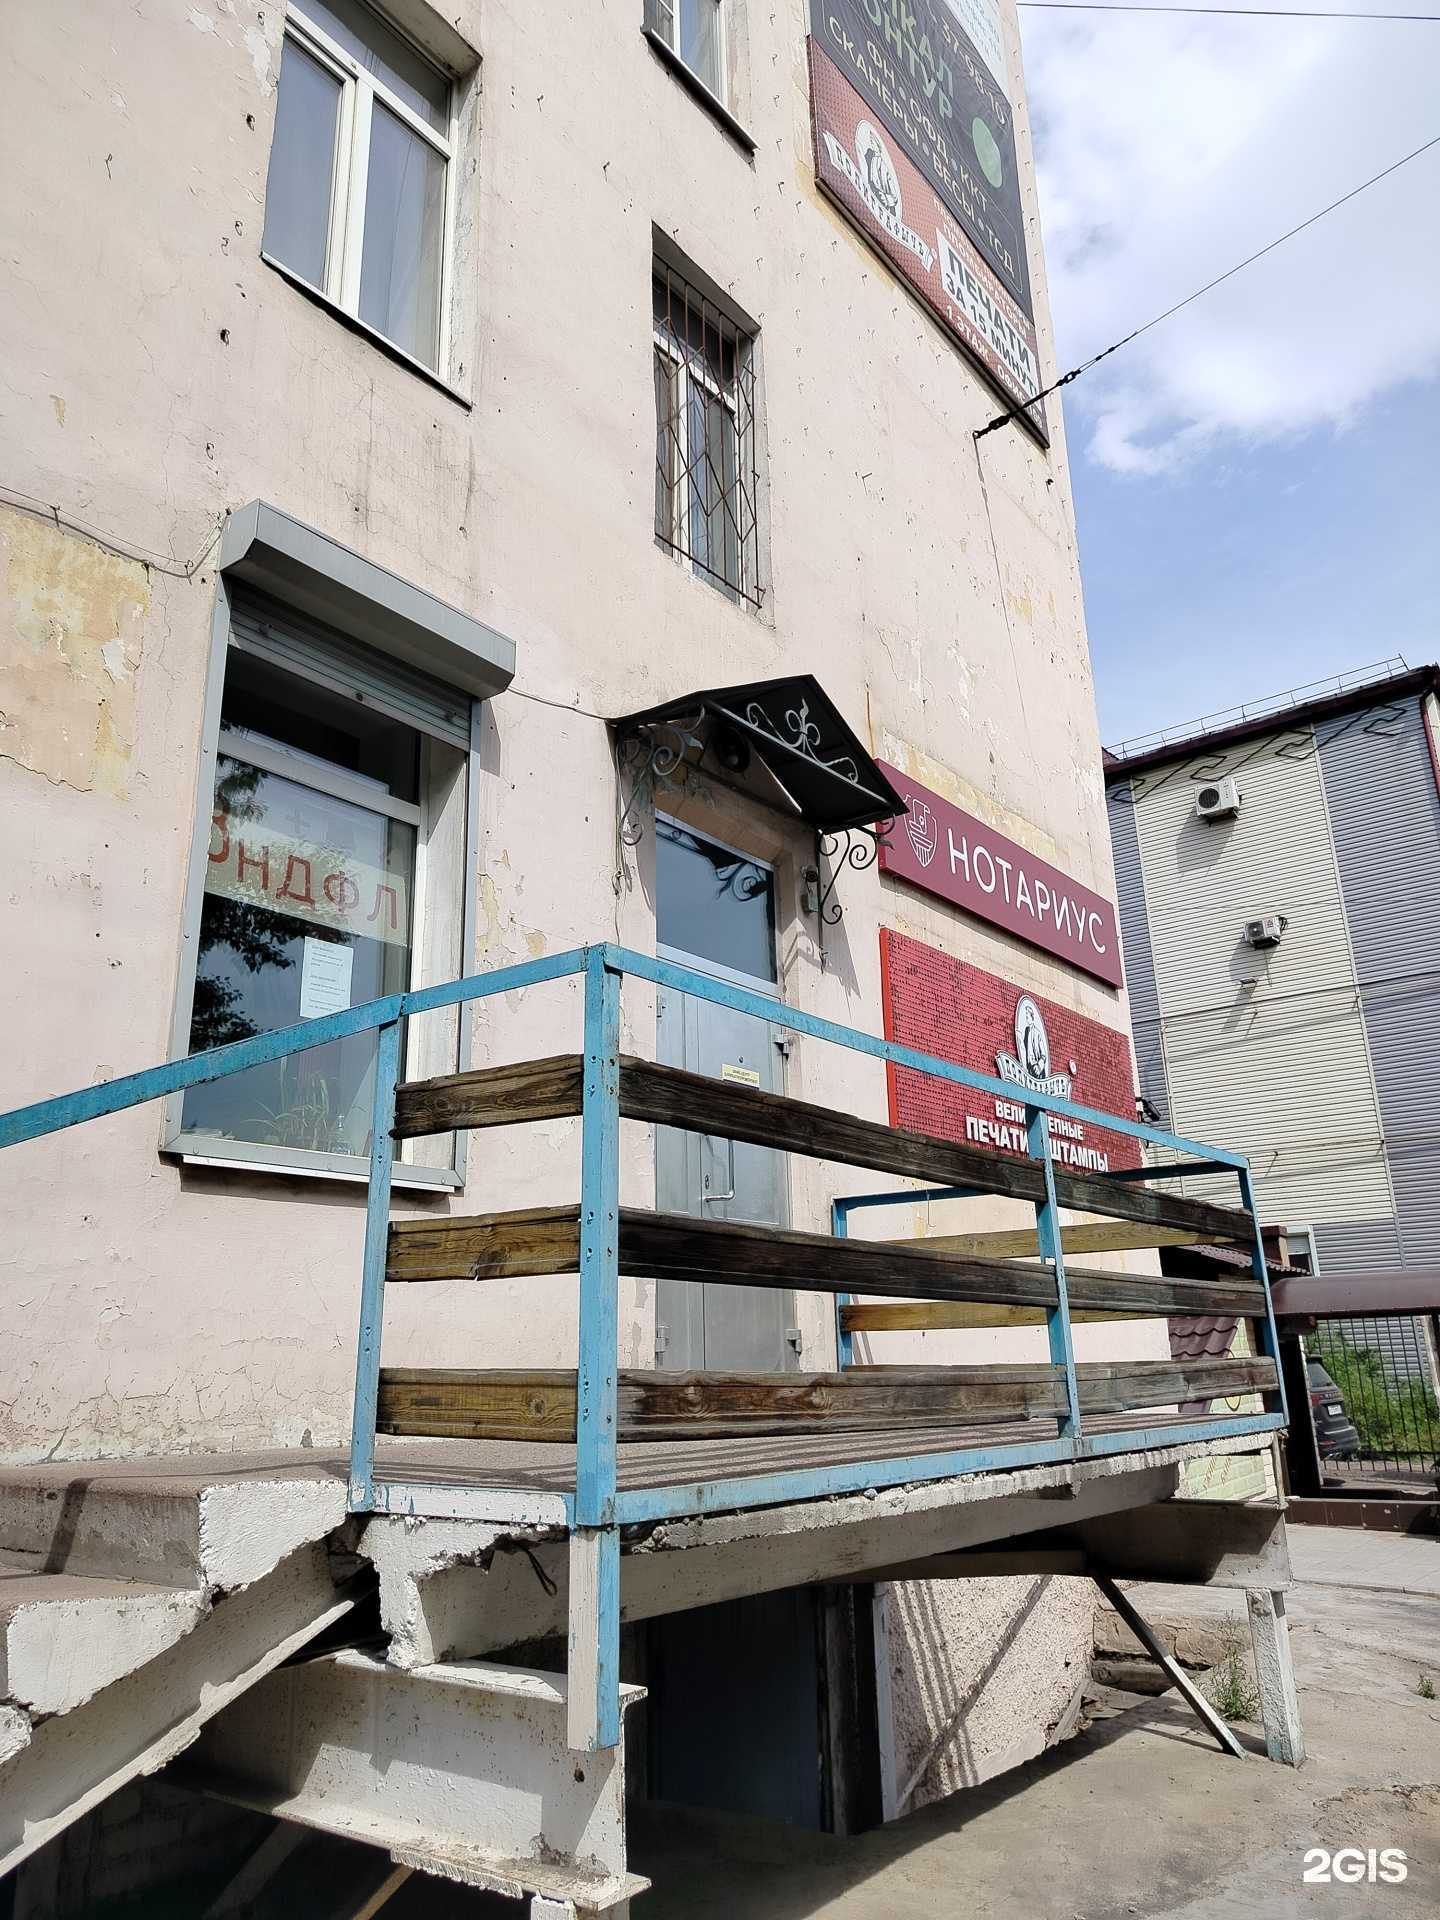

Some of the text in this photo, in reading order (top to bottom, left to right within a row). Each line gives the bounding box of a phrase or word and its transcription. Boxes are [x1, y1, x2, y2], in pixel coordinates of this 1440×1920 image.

[867, 41, 895, 89] ФН
[829, 16, 1015, 279] СКАНЕРЫ ВЕСЫ ТСД
[945, 272, 966, 310] ЗА
[970, 304, 987, 334] 15
[948, 246, 1031, 373] ПЕЧАТИ
[956, 318, 990, 362] ЭТАЖ
[947, 827, 1107, 955] НОТАРИУС
[965, 1115, 1109, 1172] ПЕЧАТИ ШТАМПЫ
